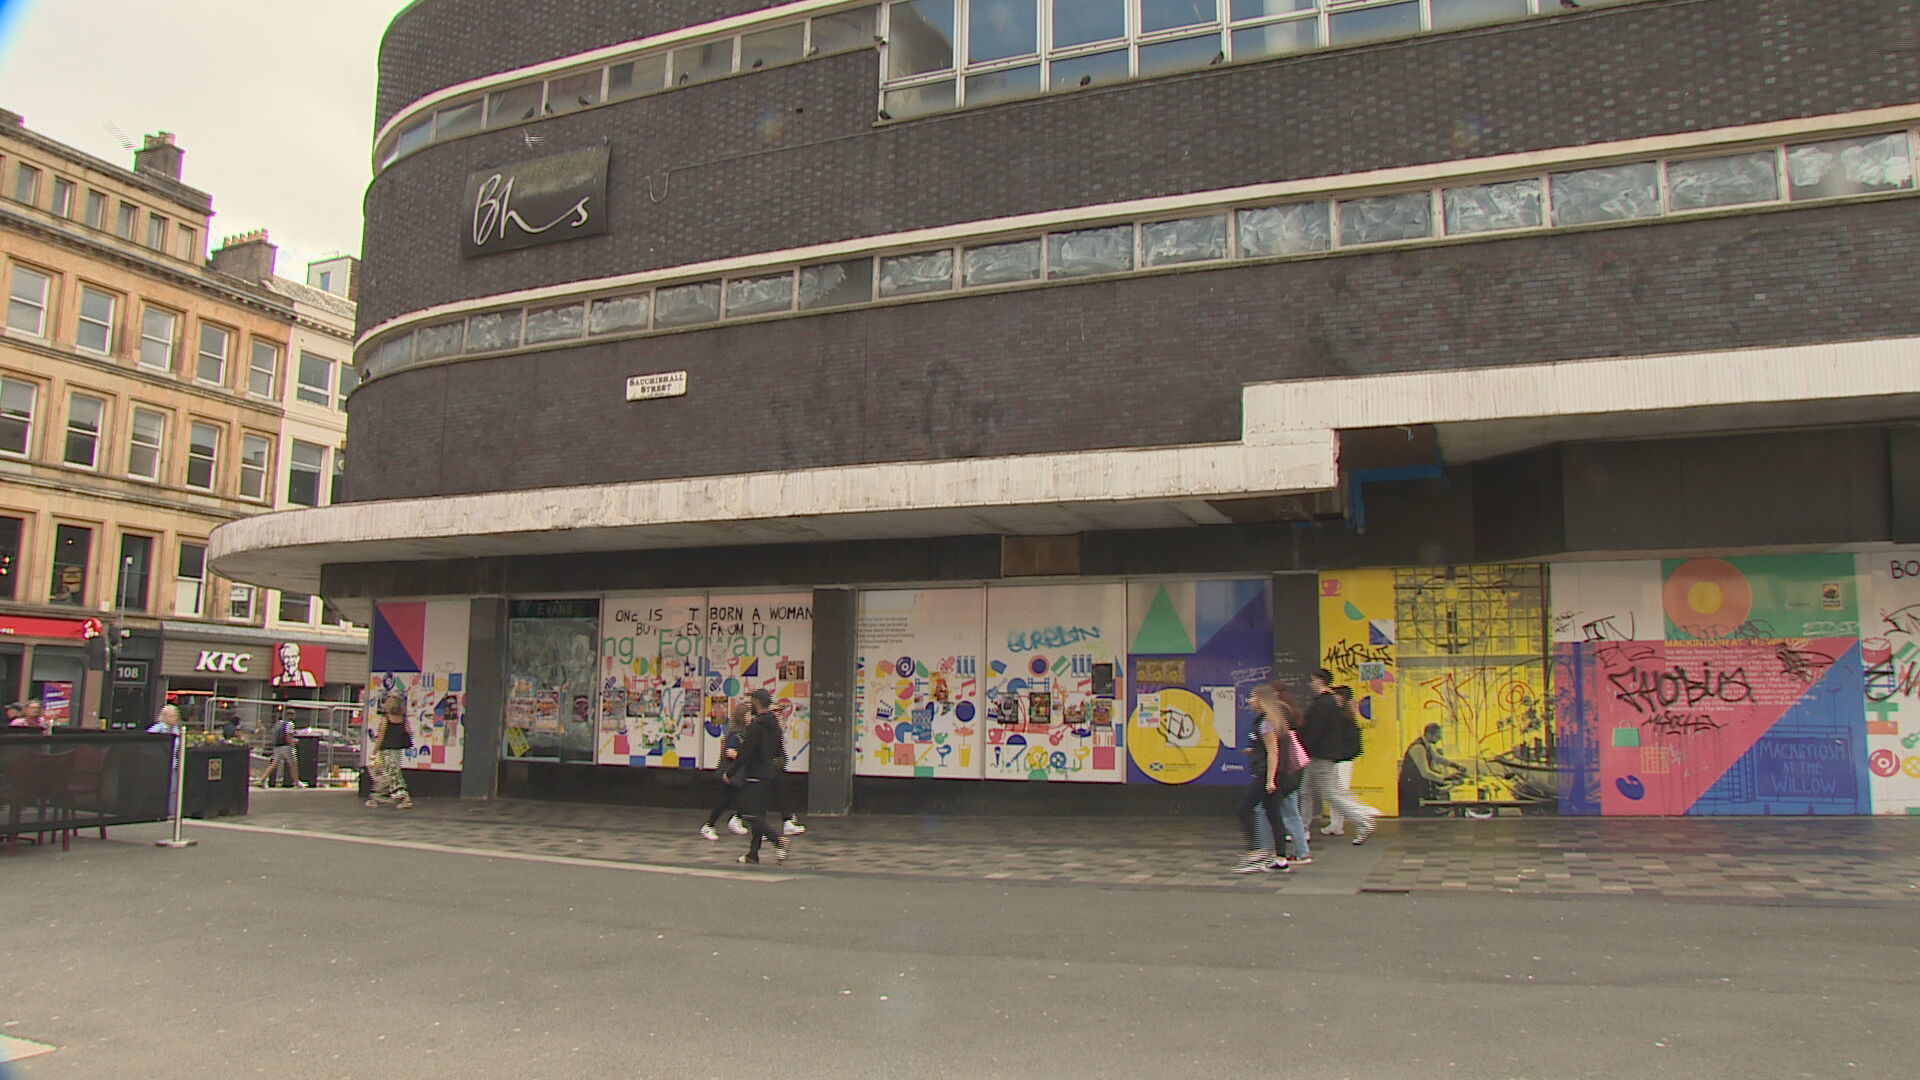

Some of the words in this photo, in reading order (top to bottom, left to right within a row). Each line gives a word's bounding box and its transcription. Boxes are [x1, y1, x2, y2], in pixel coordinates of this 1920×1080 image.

[472, 173, 591, 246] Bhs
[629, 374, 684, 387] SAUCHIEHALL
[641, 384, 672, 394] STREET
[649, 608, 663, 621] IS
[710, 606, 743, 621] BORN
[752, 607, 761, 620] A
[769, 606, 813, 621] WOMAN
[195, 650, 252, 673] KFC
[117, 667, 139, 678] 108
[1760, 741, 1846, 760] MACKINTOSH
[1800, 760, 1824, 775] THE
[1771, 774, 1836, 794] WILLOW
